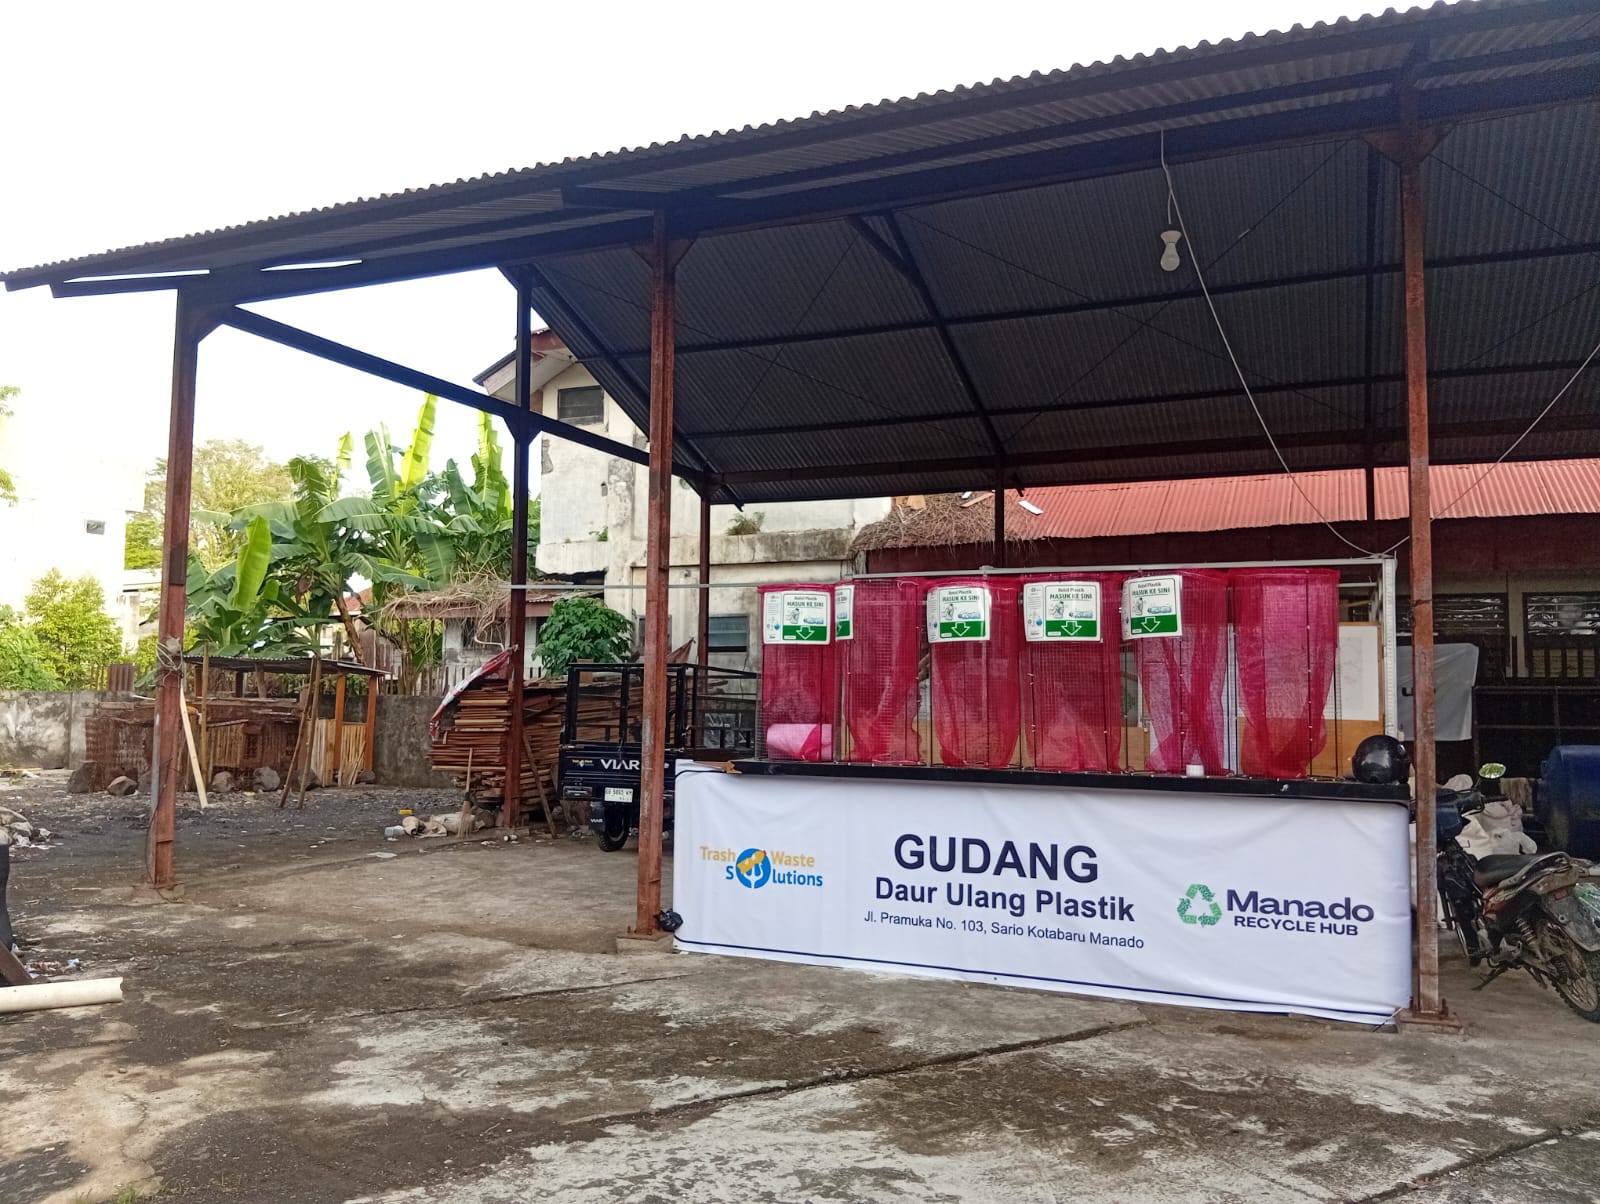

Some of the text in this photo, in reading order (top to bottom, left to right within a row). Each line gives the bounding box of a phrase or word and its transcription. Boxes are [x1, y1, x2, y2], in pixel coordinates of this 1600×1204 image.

[699, 845, 815, 868] Trash Waste
[894, 833, 1099, 884] GUDANG
[875, 876, 1135, 922] Daur Ulang Plastik
[1226, 889, 1375, 922] Manado
[864, 911, 1145, 949] Jl. Pramuka No. 103, Sario Kotabaru Manado
[1233, 915, 1358, 936] RECYCLE HUB
